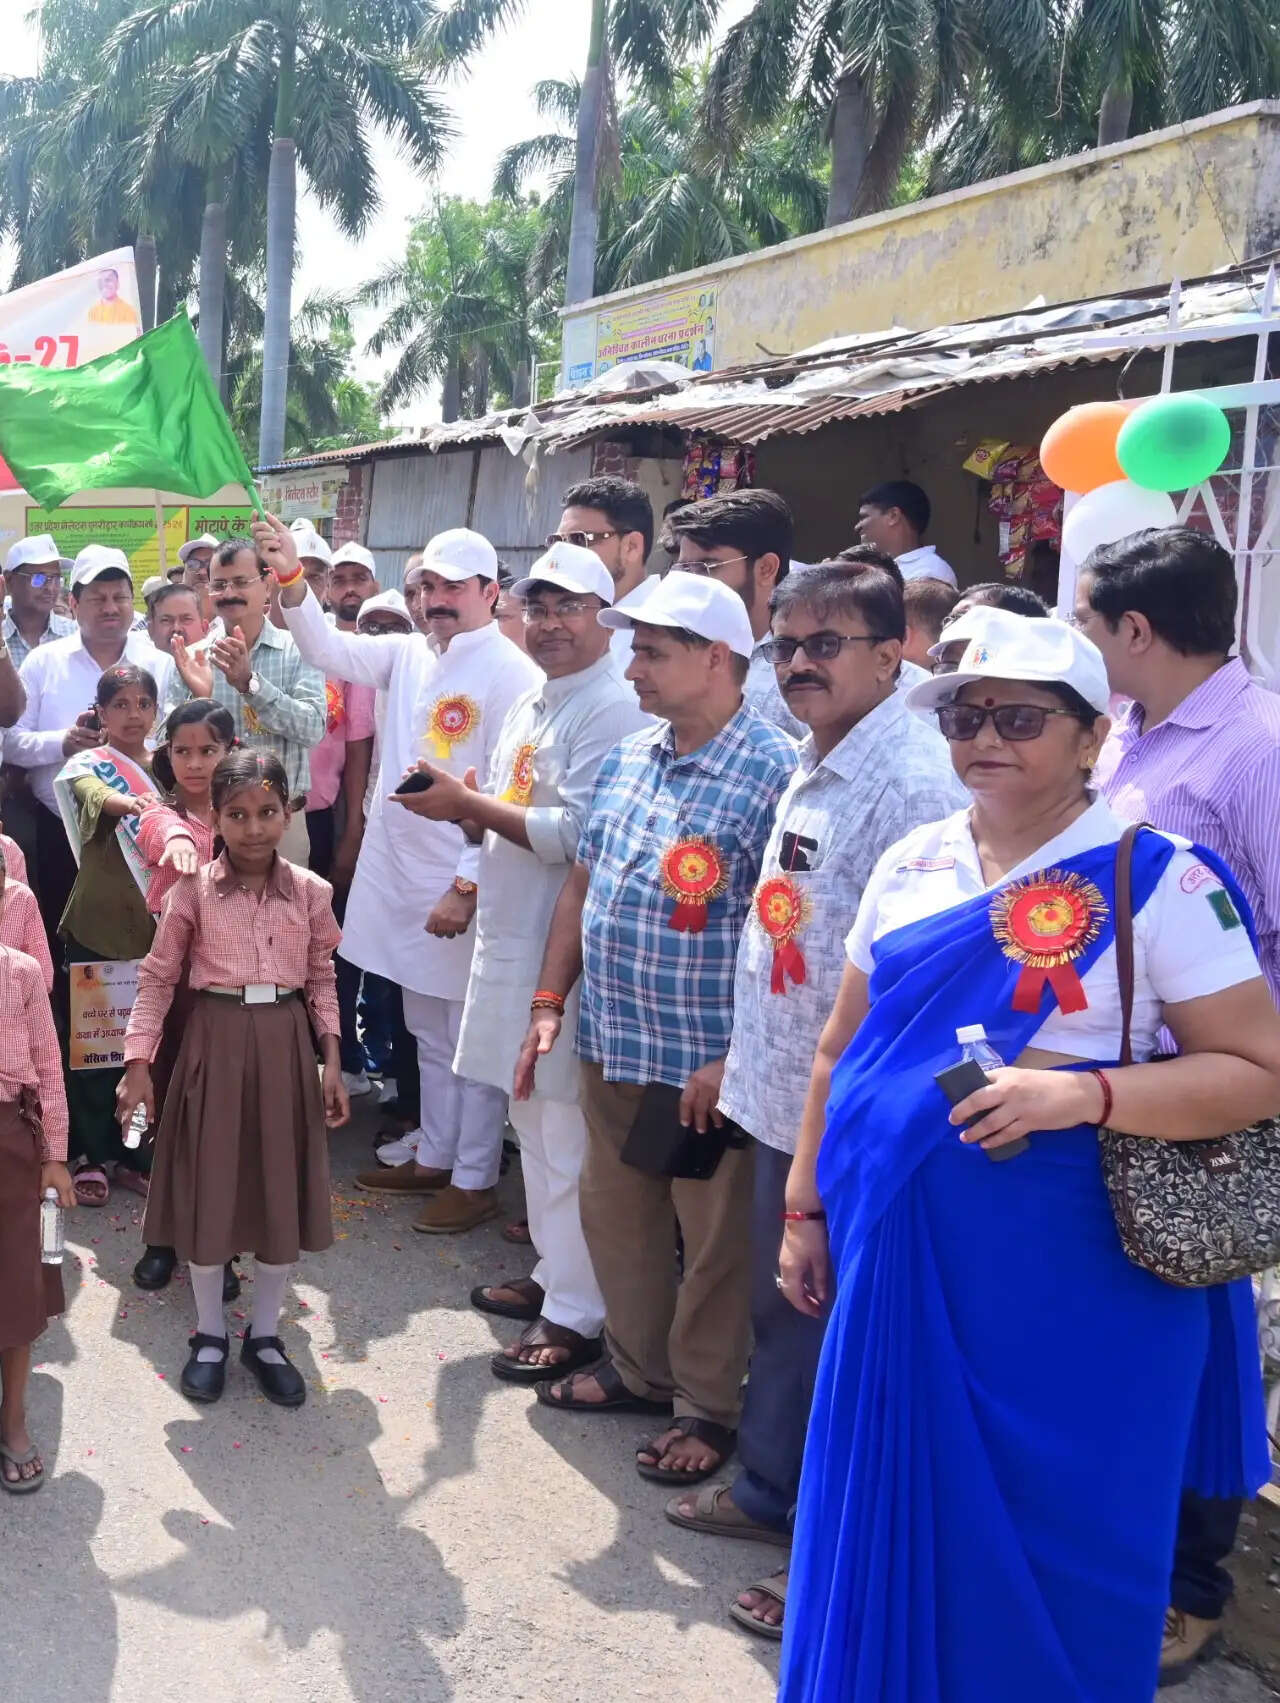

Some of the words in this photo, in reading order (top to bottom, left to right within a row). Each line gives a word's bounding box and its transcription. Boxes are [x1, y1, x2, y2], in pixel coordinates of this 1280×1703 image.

[679, 324, 704, 339] प्रदर्शन
[195, 516, 230, 534] मोटापे
[231, 516, 247, 531] के
[1209, 1151, 1234, 1167] zouk
